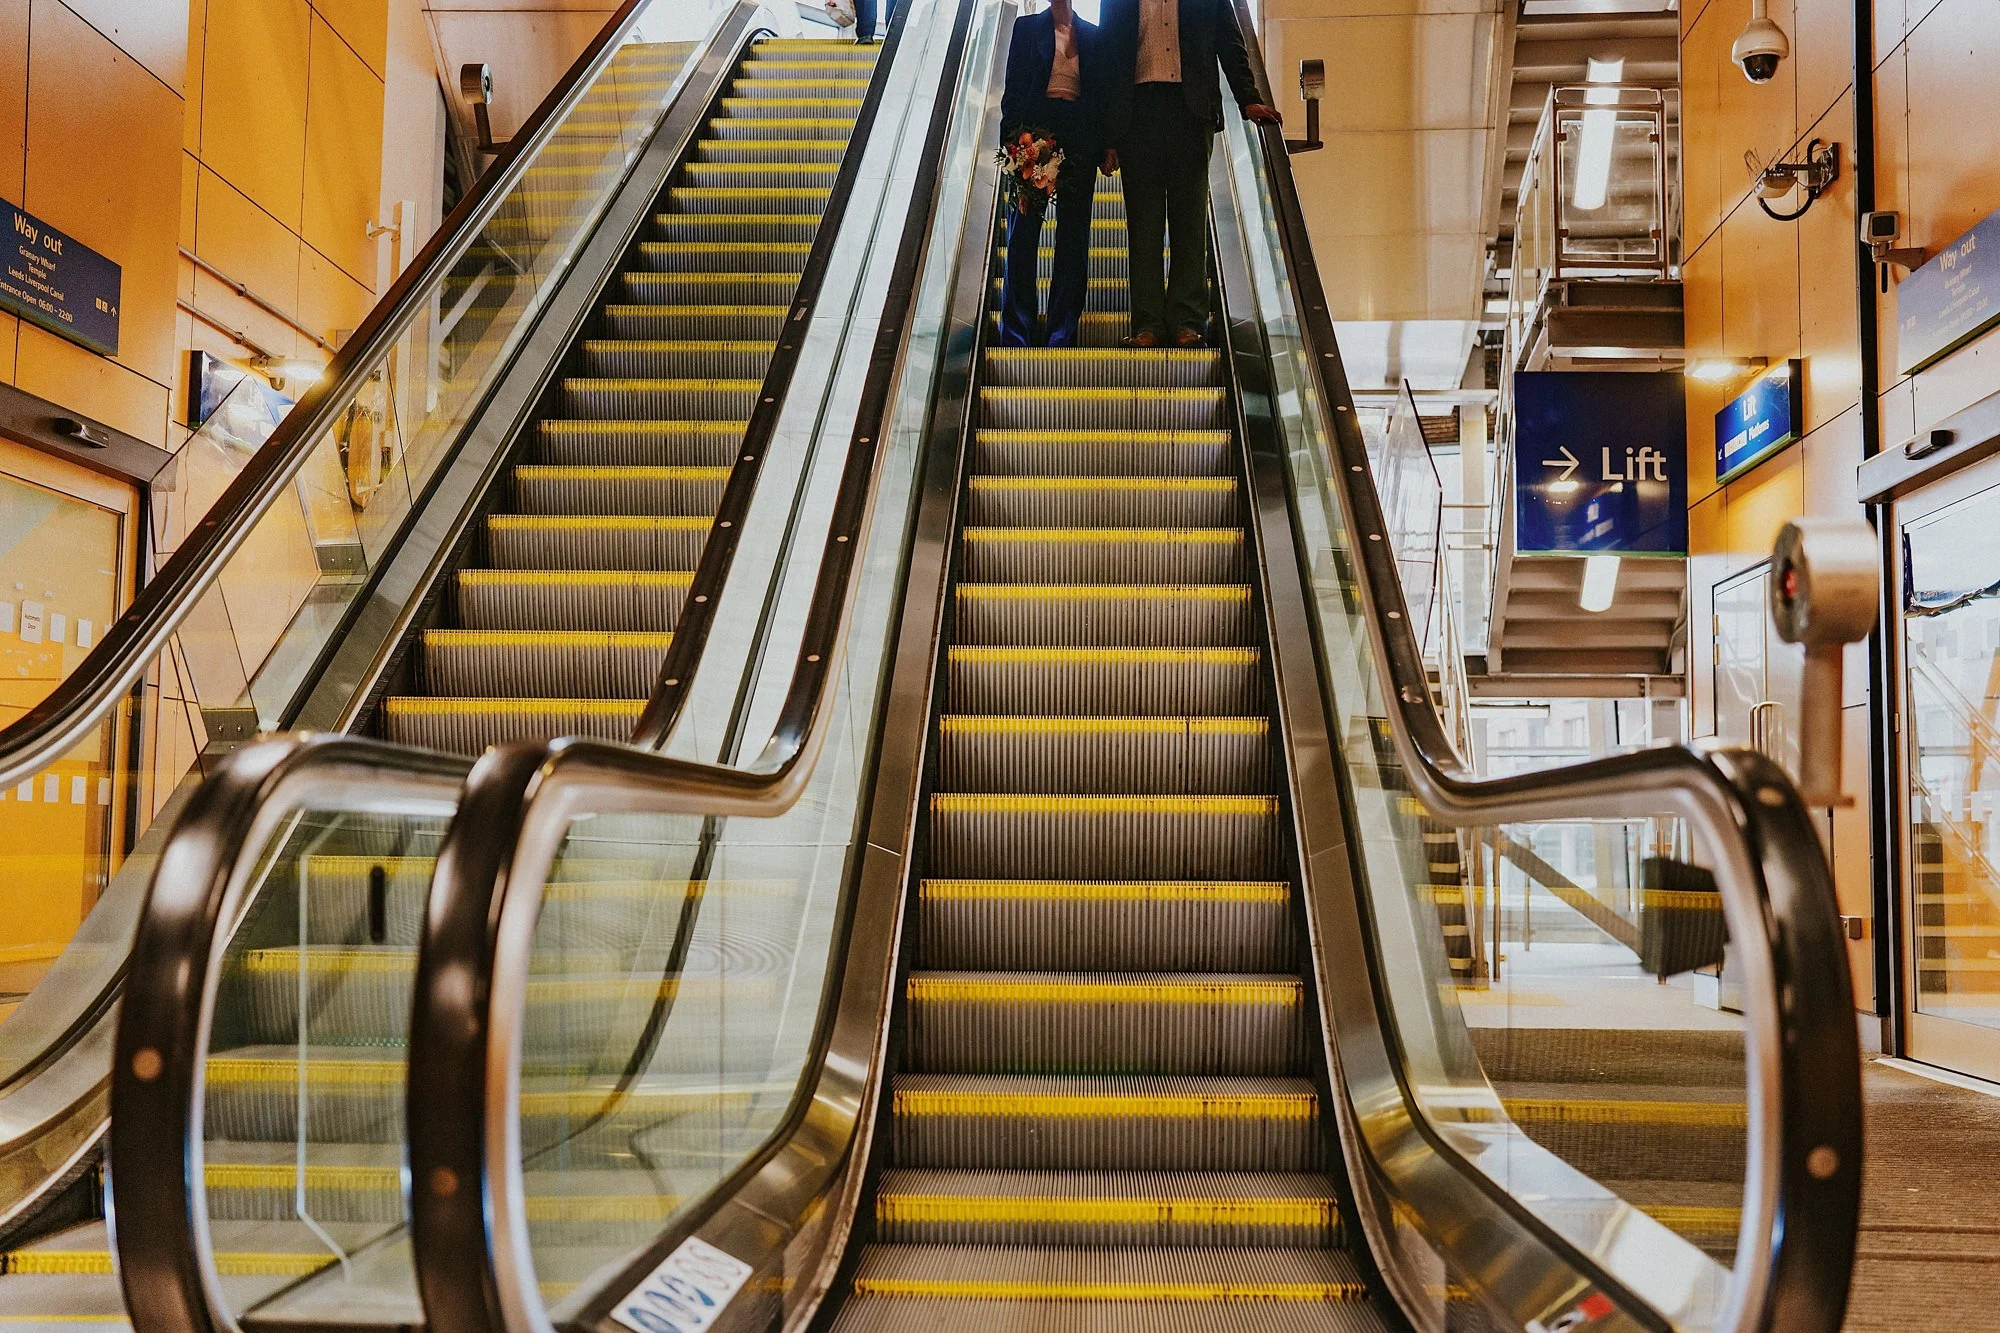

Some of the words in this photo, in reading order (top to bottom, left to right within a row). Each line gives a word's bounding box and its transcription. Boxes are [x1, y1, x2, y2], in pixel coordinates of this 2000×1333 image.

[14, 212, 38, 245] Way
[43, 235, 63, 256] out
[19, 245, 40, 264] Granary
[40, 256, 56, 272] Wharf
[1939, 249, 1957, 273] Way
[1960, 233, 1976, 257] out
[8, 265, 25, 281] Leeds
[25, 273, 50, 294] Liverpool
[49, 286, 65, 302] Canal
[28, 262, 47, 280] Temple
[22, 290, 37, 305] Open
[58, 308, 73, 323] 22:00
[1743, 394, 1757, 421] Lift
[1601, 446, 1668, 481] Lift
